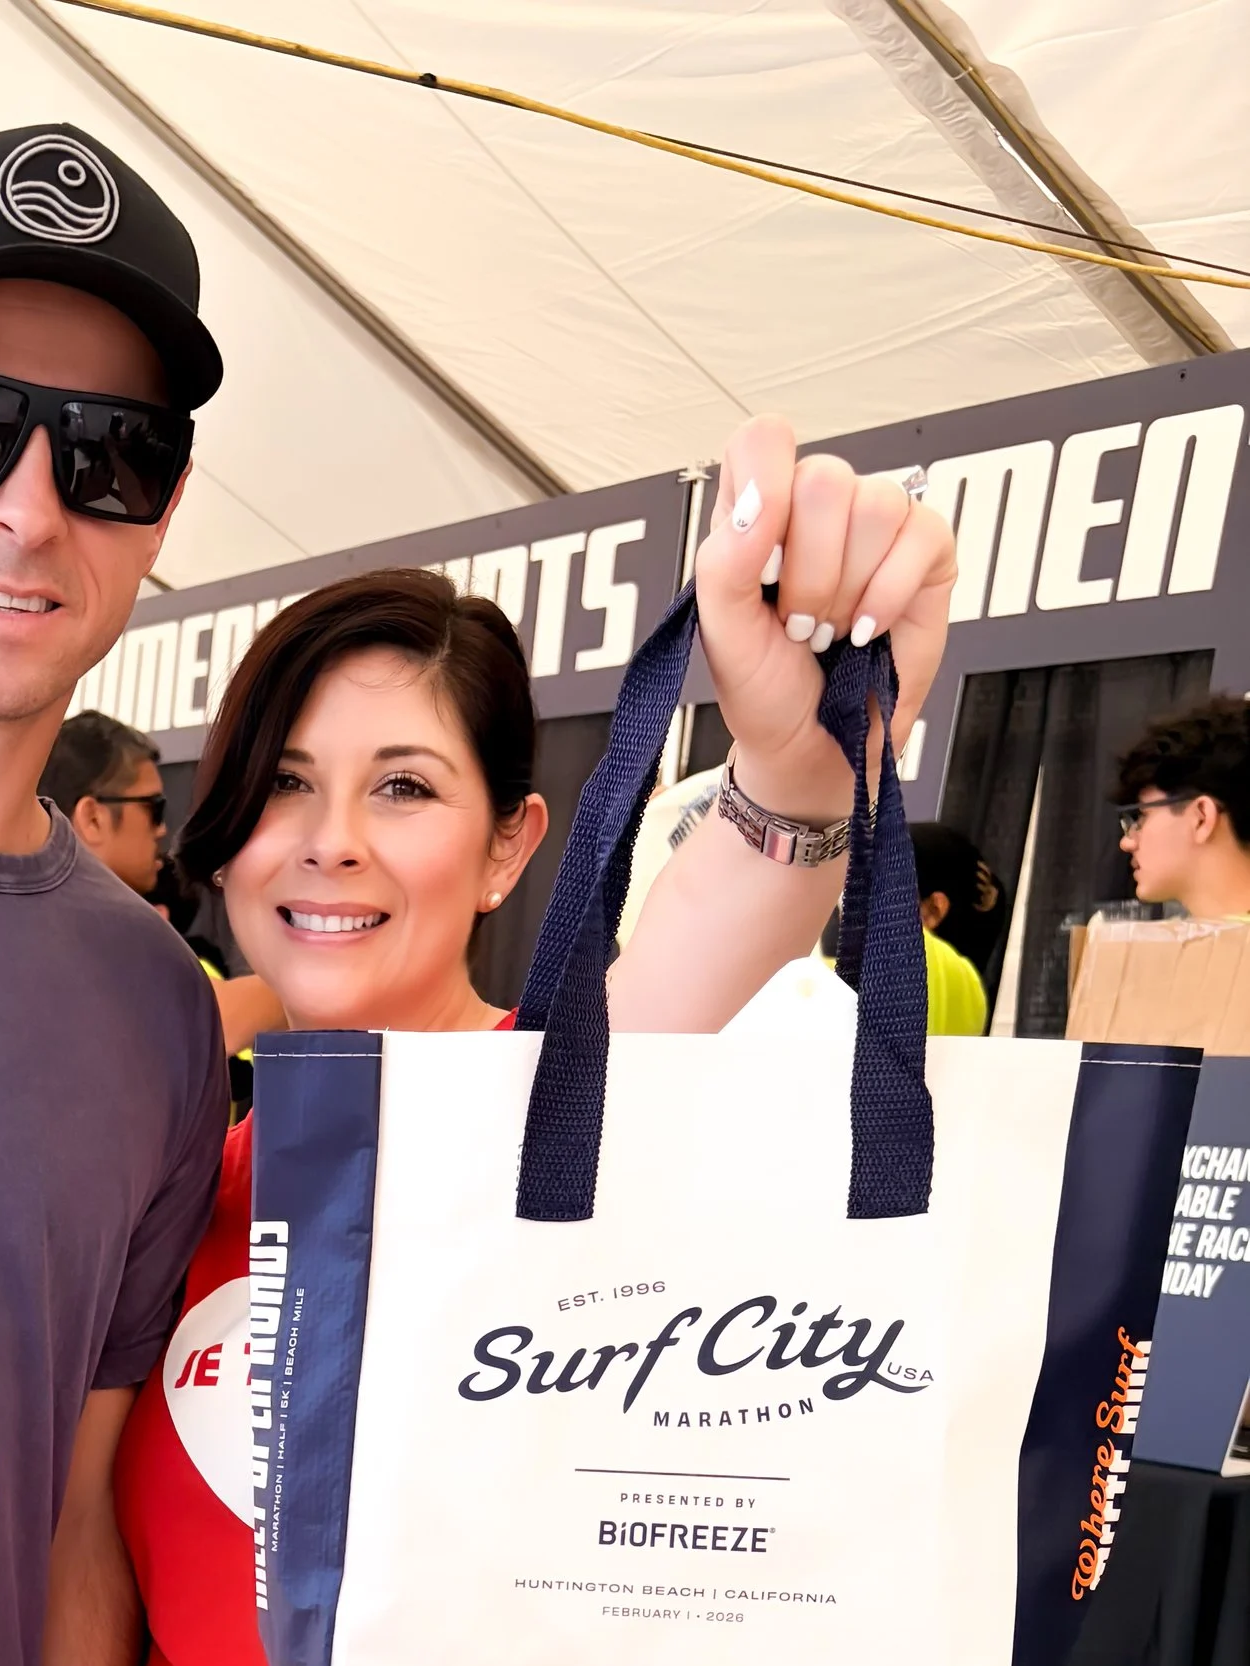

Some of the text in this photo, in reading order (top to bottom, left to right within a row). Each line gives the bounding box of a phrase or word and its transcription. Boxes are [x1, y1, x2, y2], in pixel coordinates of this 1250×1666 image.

[862, 404, 1245, 624] MEN
[1174, 1184, 1242, 1221] ABLE
[1195, 1224, 1250, 1262] RAC
[293, 1288, 305, 1321] MILE
[557, 1280, 667, 1312] EST. 1996
[458, 1295, 935, 1414] Surf City USA
[280, 1391, 290, 1409] 5K
[653, 1398, 815, 1428] MARATHON
[278, 1424, 288, 1460] HALF
[1071, 1438, 1115, 1600] Where
[1095, 1326, 1145, 1433] Surf
[272, 1474, 284, 1552] MARATHON
[620, 1492, 757, 1509] PRESENTED BY
[514, 1578, 837, 1604] HUNTINGTON BEACH CALIFORNIA
[602, 1606, 681, 1620] FEBRUARY
[706, 1611, 744, 1623] 2026
